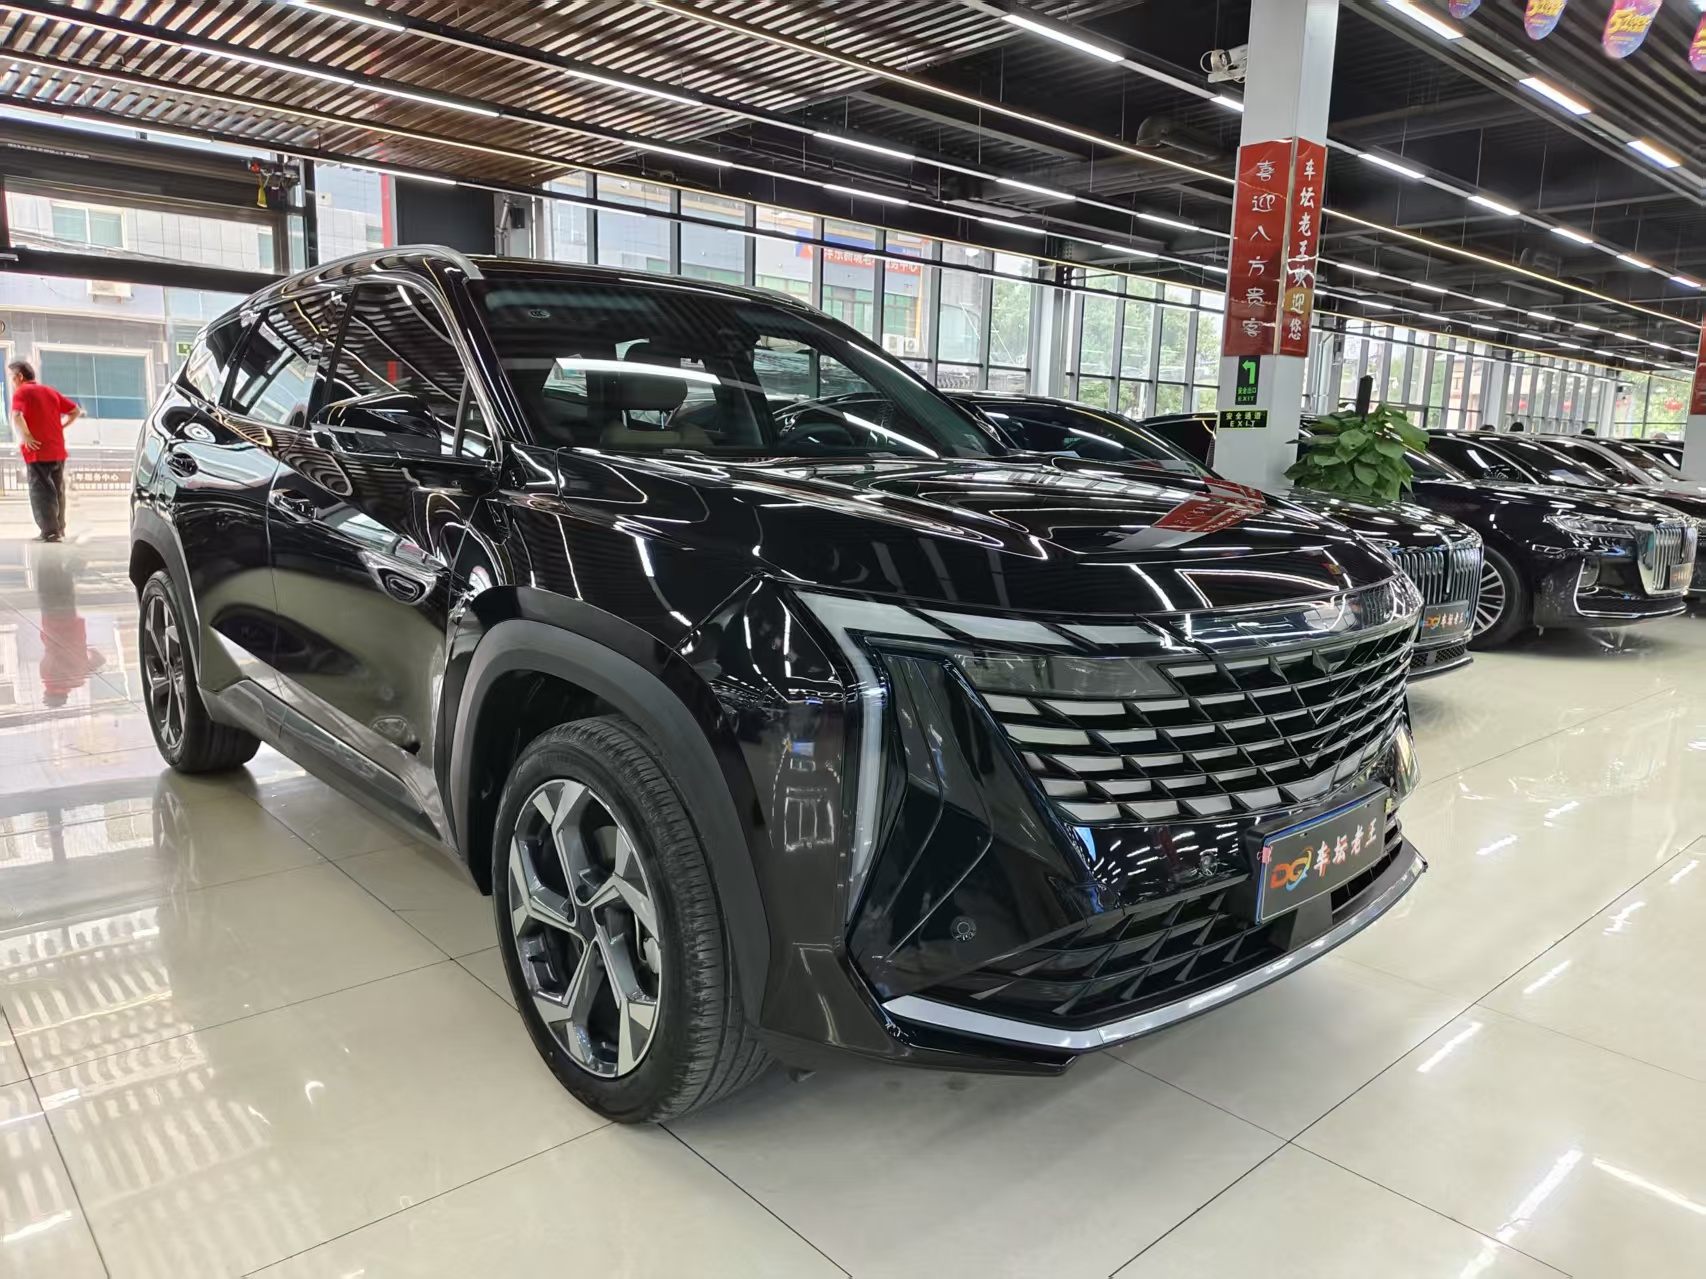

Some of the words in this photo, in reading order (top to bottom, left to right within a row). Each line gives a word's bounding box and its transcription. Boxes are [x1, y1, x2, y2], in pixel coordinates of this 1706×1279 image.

[1242, 159, 1276, 337] 喜迎八方贵客
[1288, 158, 1317, 341] 车坛老王欢迎您
